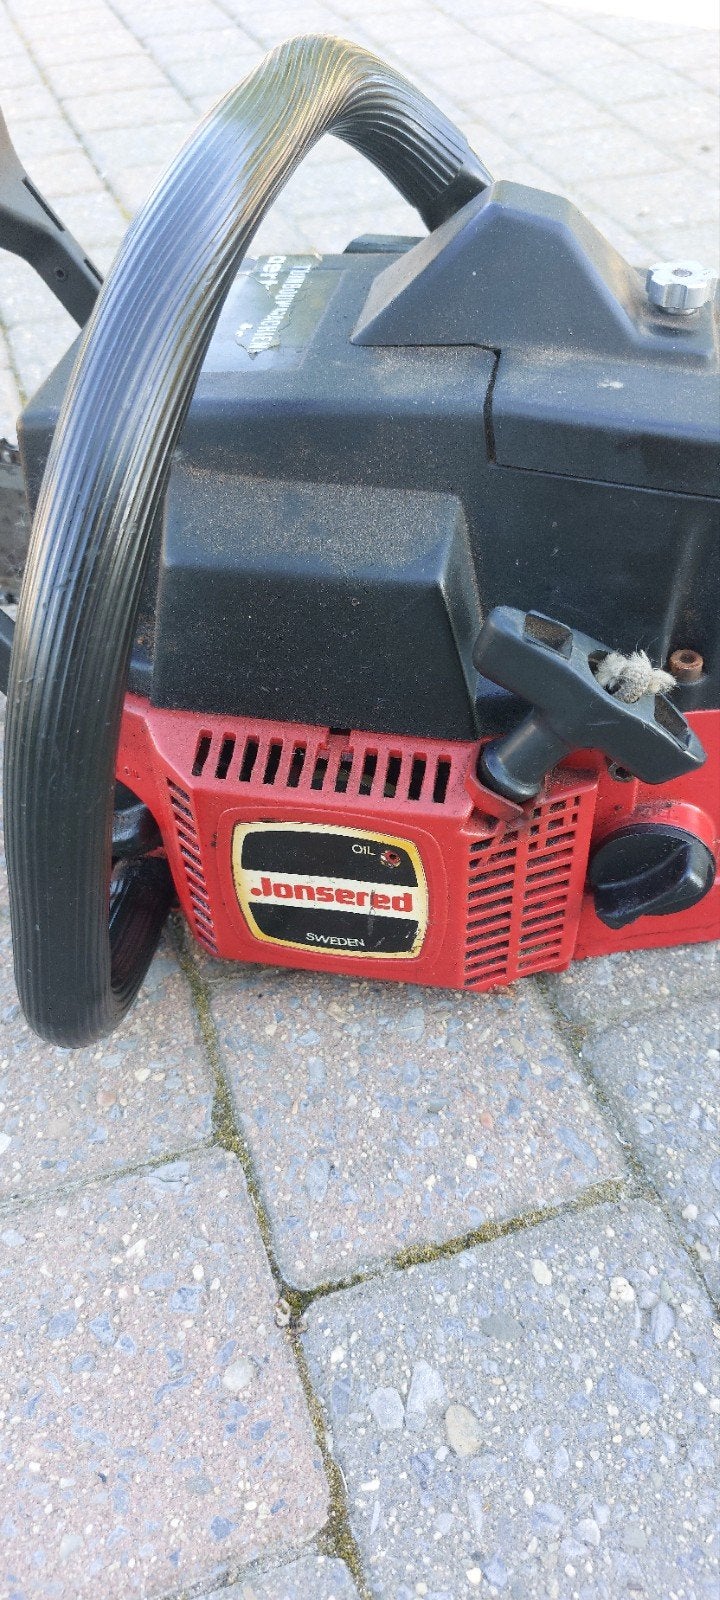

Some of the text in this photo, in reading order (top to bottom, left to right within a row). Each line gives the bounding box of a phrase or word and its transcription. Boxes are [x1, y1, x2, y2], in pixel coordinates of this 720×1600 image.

[351, 844, 376, 856] OIL
[250, 877, 413, 913] Jonsered
[305, 932, 366, 948] SWEDEN
